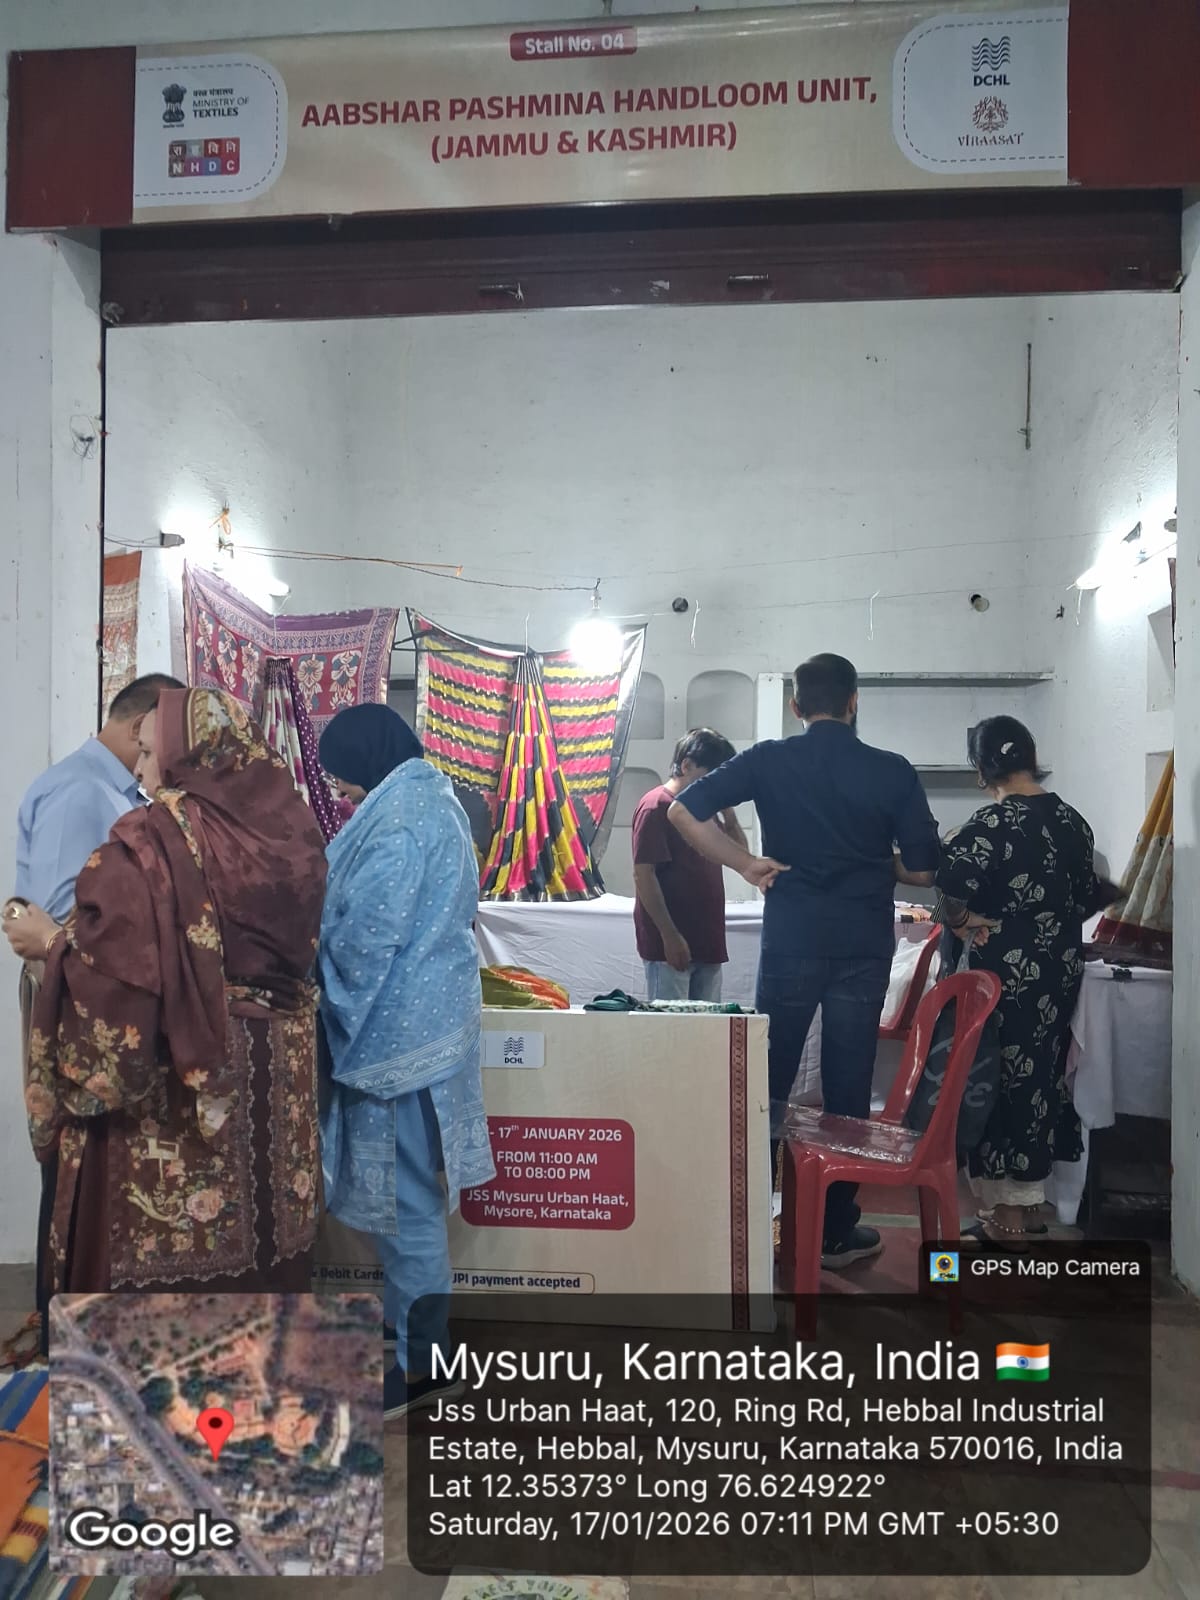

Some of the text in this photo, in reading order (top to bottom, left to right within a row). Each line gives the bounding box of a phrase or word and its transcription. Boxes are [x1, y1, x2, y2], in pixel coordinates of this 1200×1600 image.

[525, 33, 624, 55] Stall No. 04
[973, 74, 1011, 87] DCHL
[193, 97, 248, 107] MINISTRY OF
[302, 76, 878, 128] AABSHAR PASHMINA HANDLOOM UNIT,
[193, 107, 239, 118] TEXTILES
[431, 121, 737, 164] (JAMMU & KASHMIR)
[522, 1127, 585, 1141] JANUARY
[588, 1129, 622, 1141] 2026
[496, 1151, 598, 1165] FROM 11:00 AM
[504, 1166, 591, 1180] TO 08:00 PM
[466, 1190, 629, 1207] JSS Mysuru Urban Haat,
[484, 1205, 612, 1221] Mysore, Karnataka
[472, 1275, 524, 1287] payment
[527, 1277, 581, 1289] accepted
